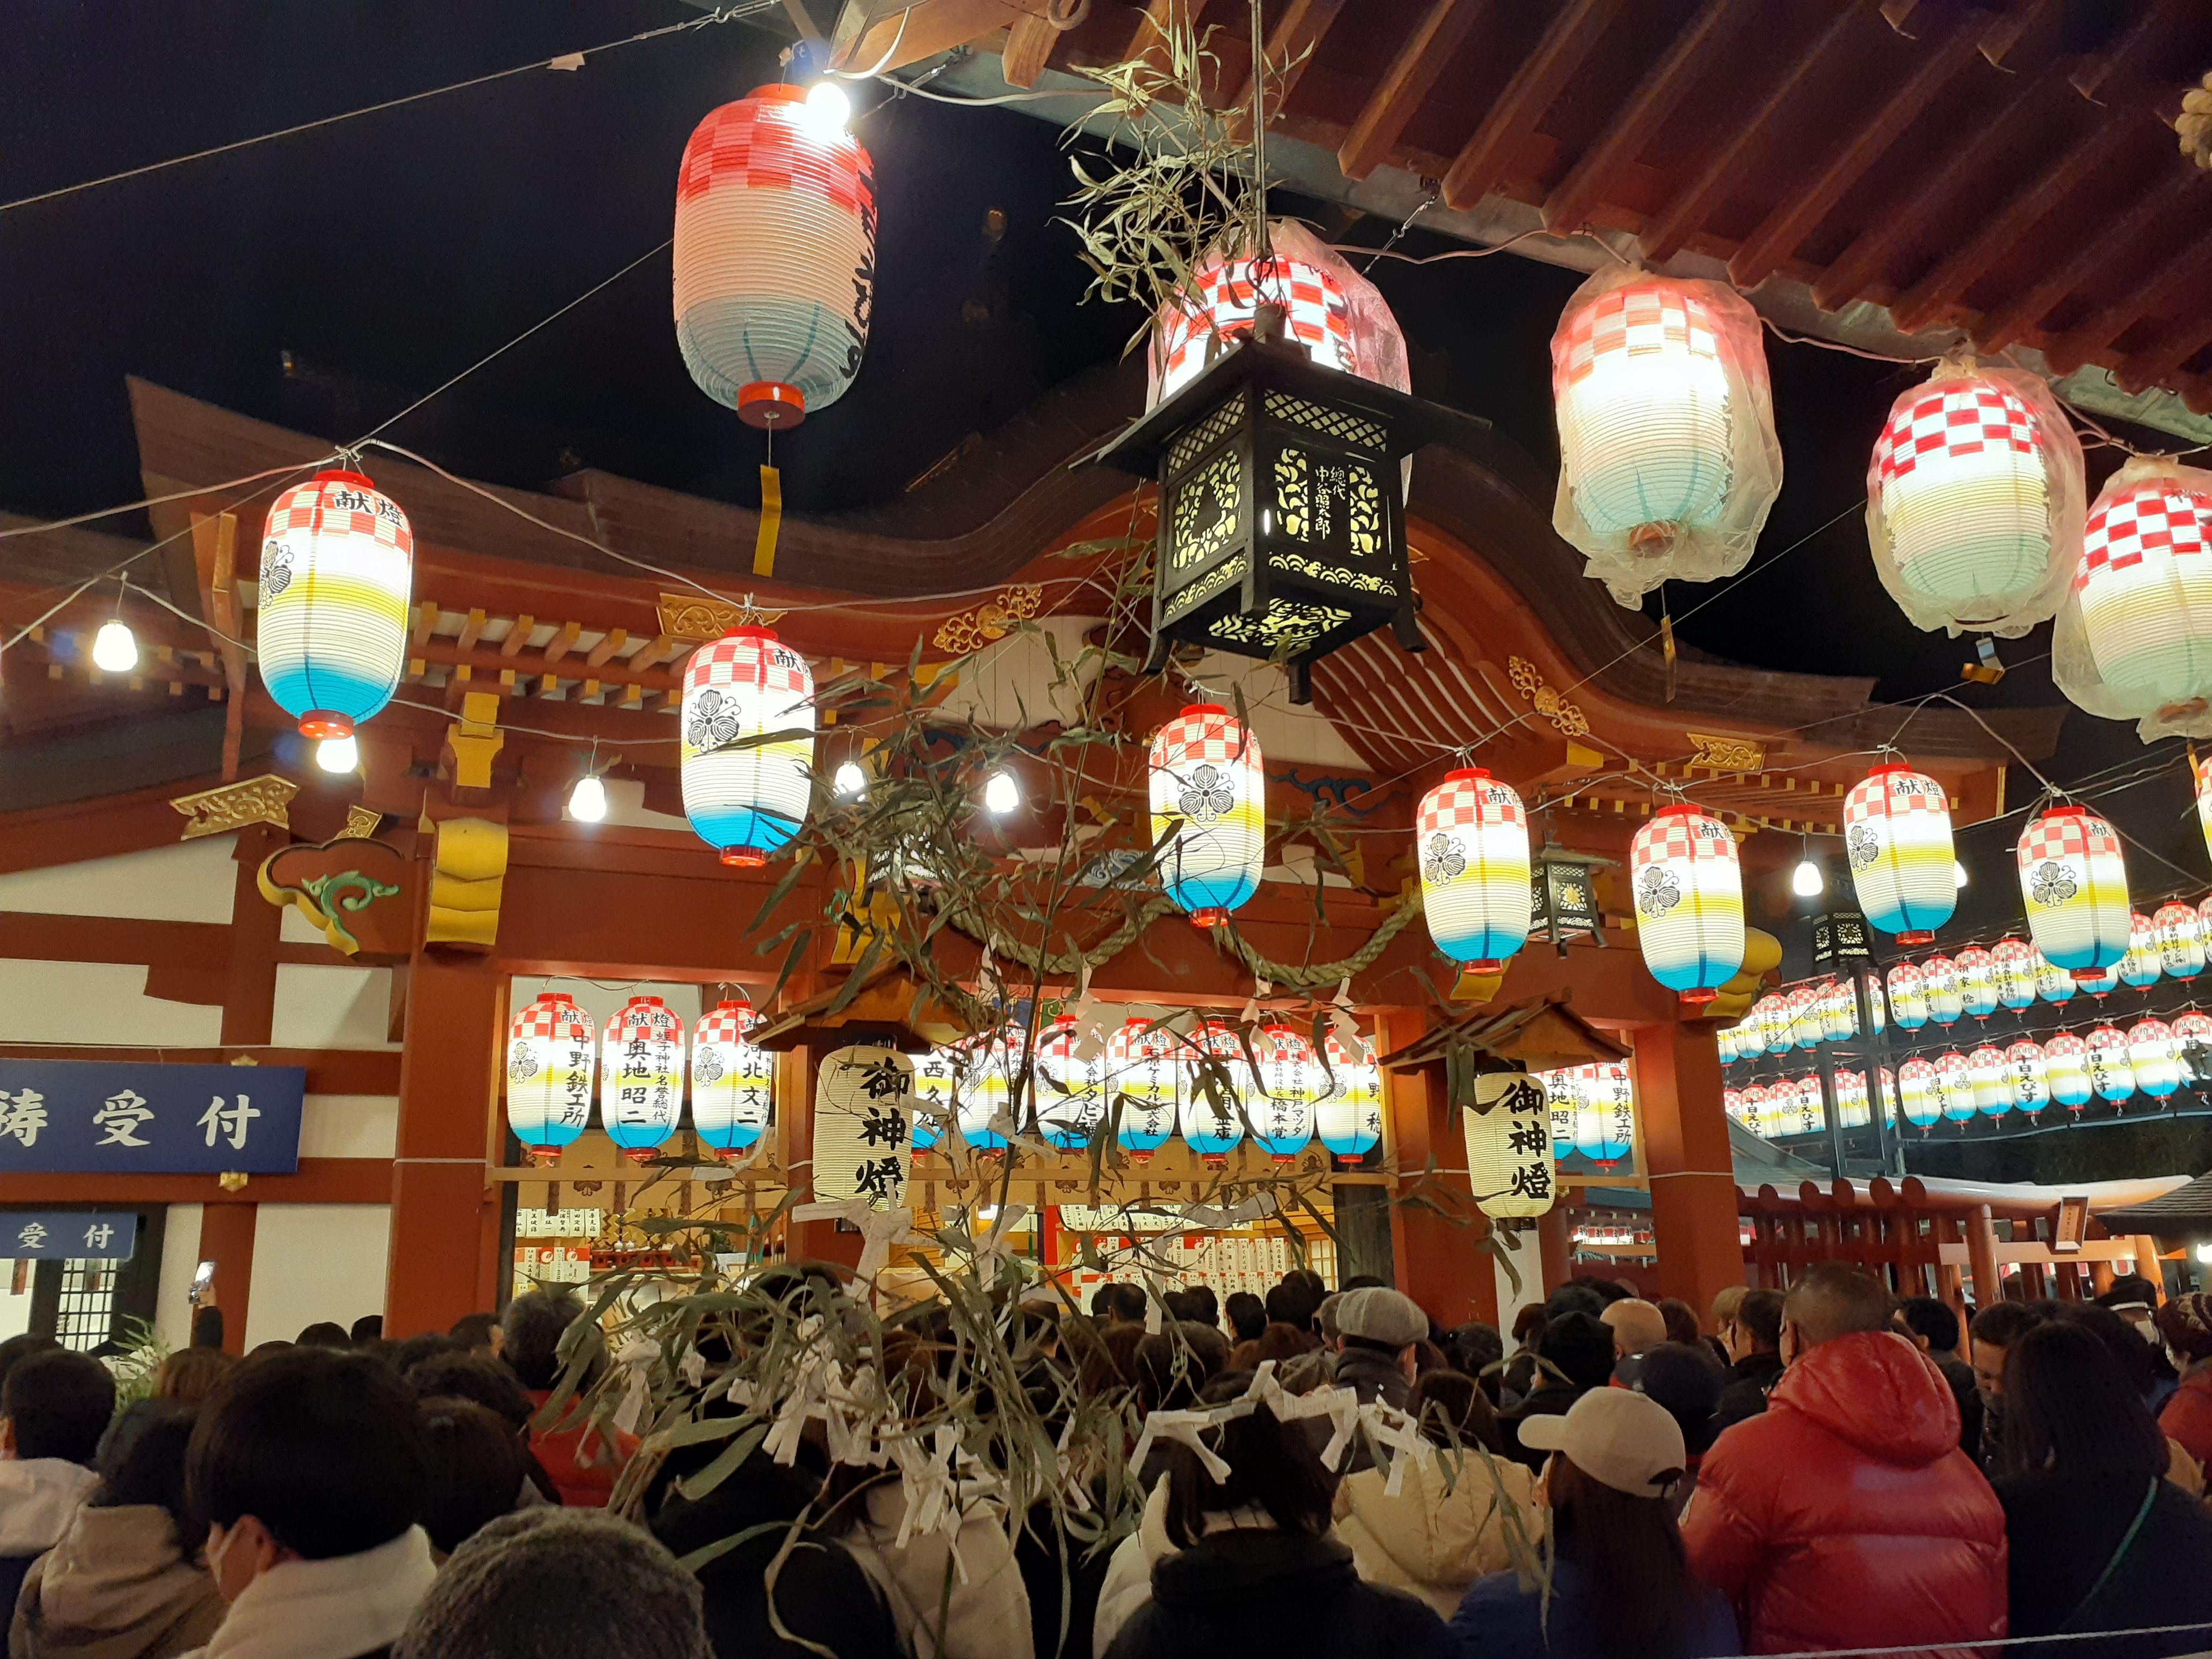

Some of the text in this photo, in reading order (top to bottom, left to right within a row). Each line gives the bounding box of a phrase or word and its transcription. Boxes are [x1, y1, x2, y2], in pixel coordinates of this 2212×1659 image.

[333, 490, 403, 528] 献燈
[774, 647, 813, 681] 献
[1894, 779, 1941, 797] 献燈
[628, 1012, 671, 1028] 献燈
[559, 1029, 591, 1127] 中野鉄工所
[619, 1037, 652, 1124] 奥地昭二
[652, 1031, 671, 1123] 蛭子神社名誉総代
[2016, 1054, 2037, 1103] 十日えびす
[2089, 1044, 2111, 1093] 十日えびす
[1290, 1052, 1306, 1137] 株式会社神戸マツダ
[1548, 1071, 1571, 1141] 奥地昭二
[1612, 1070, 1632, 1145] 中野鉄工所
[1798, 1088, 1815, 1131] 十日えびす
[1501, 1079, 1552, 1200] 御神燈
[18, 1222, 115, 1250] 受付
